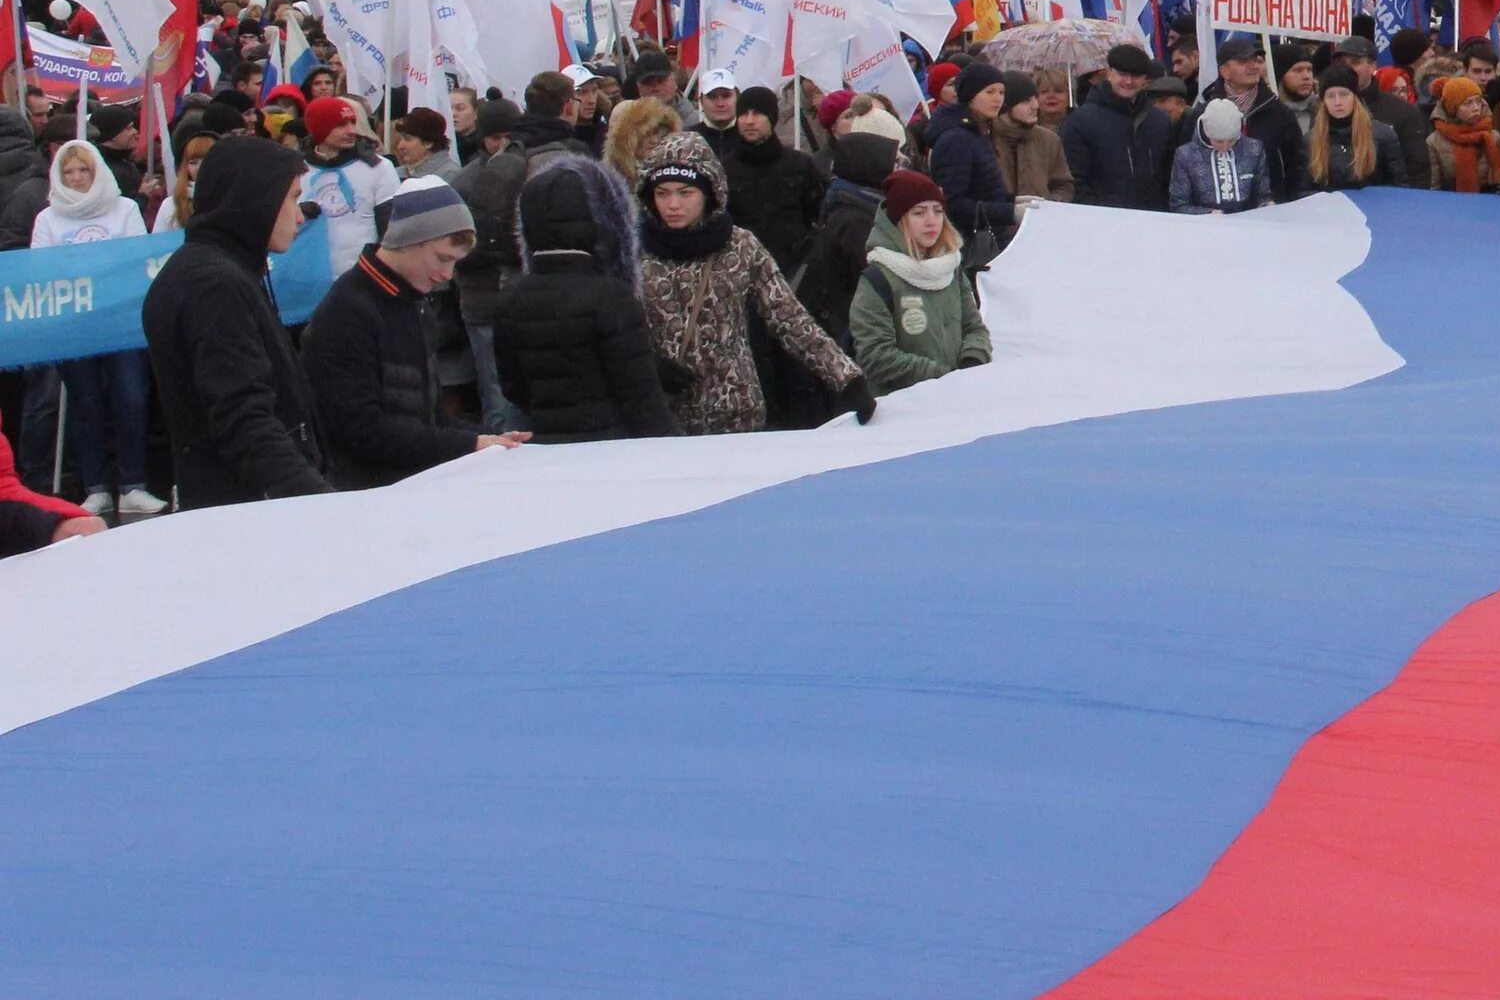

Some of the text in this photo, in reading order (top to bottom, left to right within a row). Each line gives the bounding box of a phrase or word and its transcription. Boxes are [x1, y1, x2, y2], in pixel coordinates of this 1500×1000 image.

[361, 0, 390, 14] ФРО
[33, 55, 130, 84] СУДАРСТВО, КОГ
[5, 277, 93, 323] МИРА
